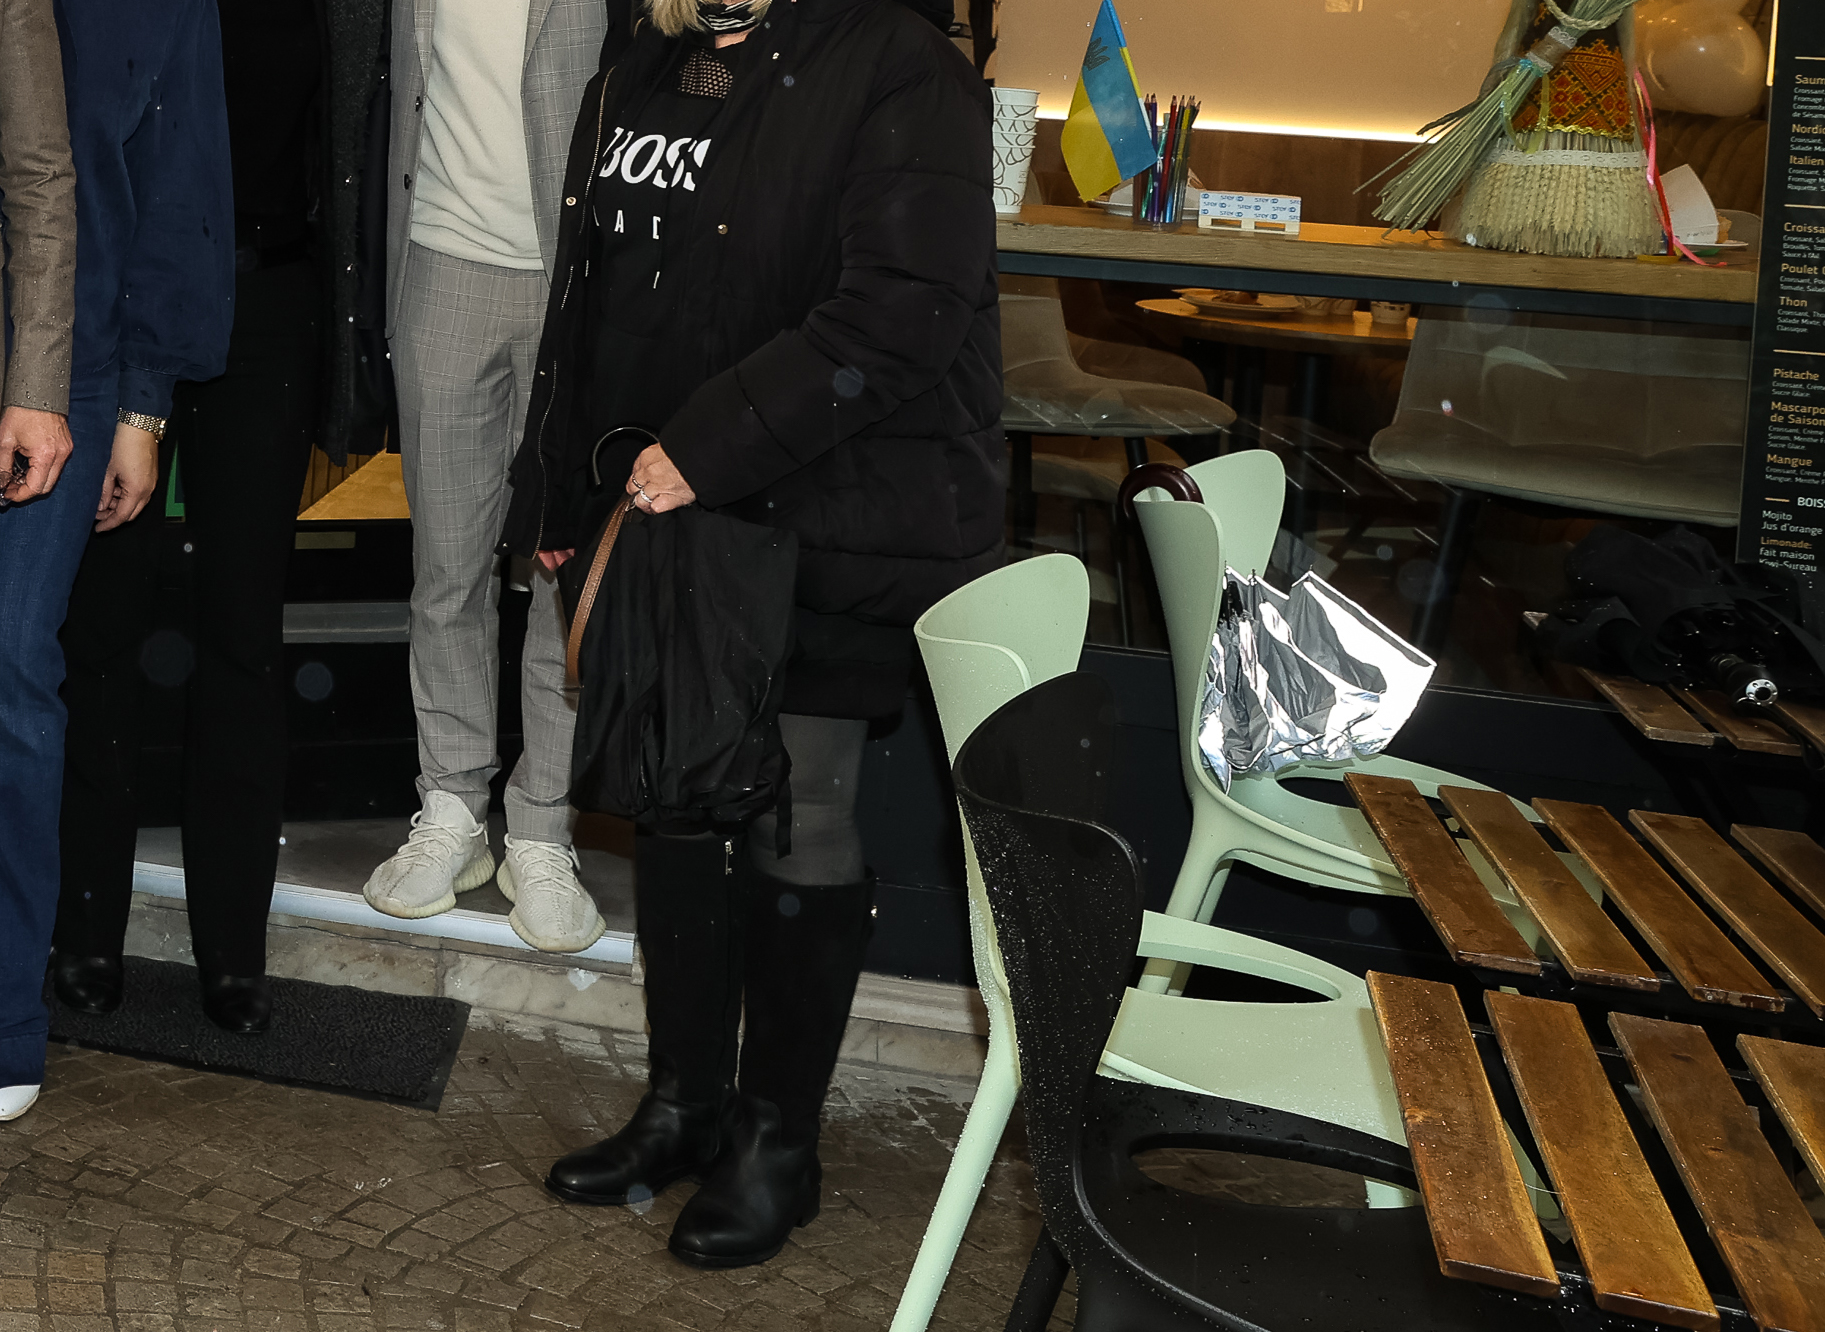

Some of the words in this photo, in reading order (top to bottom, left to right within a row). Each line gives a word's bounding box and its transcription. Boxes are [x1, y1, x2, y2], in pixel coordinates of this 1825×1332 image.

[1789, 155, 1824, 166] Italien
[1781, 263, 1818, 275] Poulet
[1779, 296, 1808, 307] Thon
[1773, 368, 1820, 381] Pistache
[1770, 413, 1784, 423] de
[1766, 453, 1813, 468] Mangue
[1797, 496, 1825, 509] BOIS
[1762, 510, 1793, 521] Mojito
[1761, 521, 1778, 529] Jus
[1760, 536, 1812, 549] Limonade:
[1759, 547, 1777, 558] fait
[1779, 548, 1815, 560] maison
